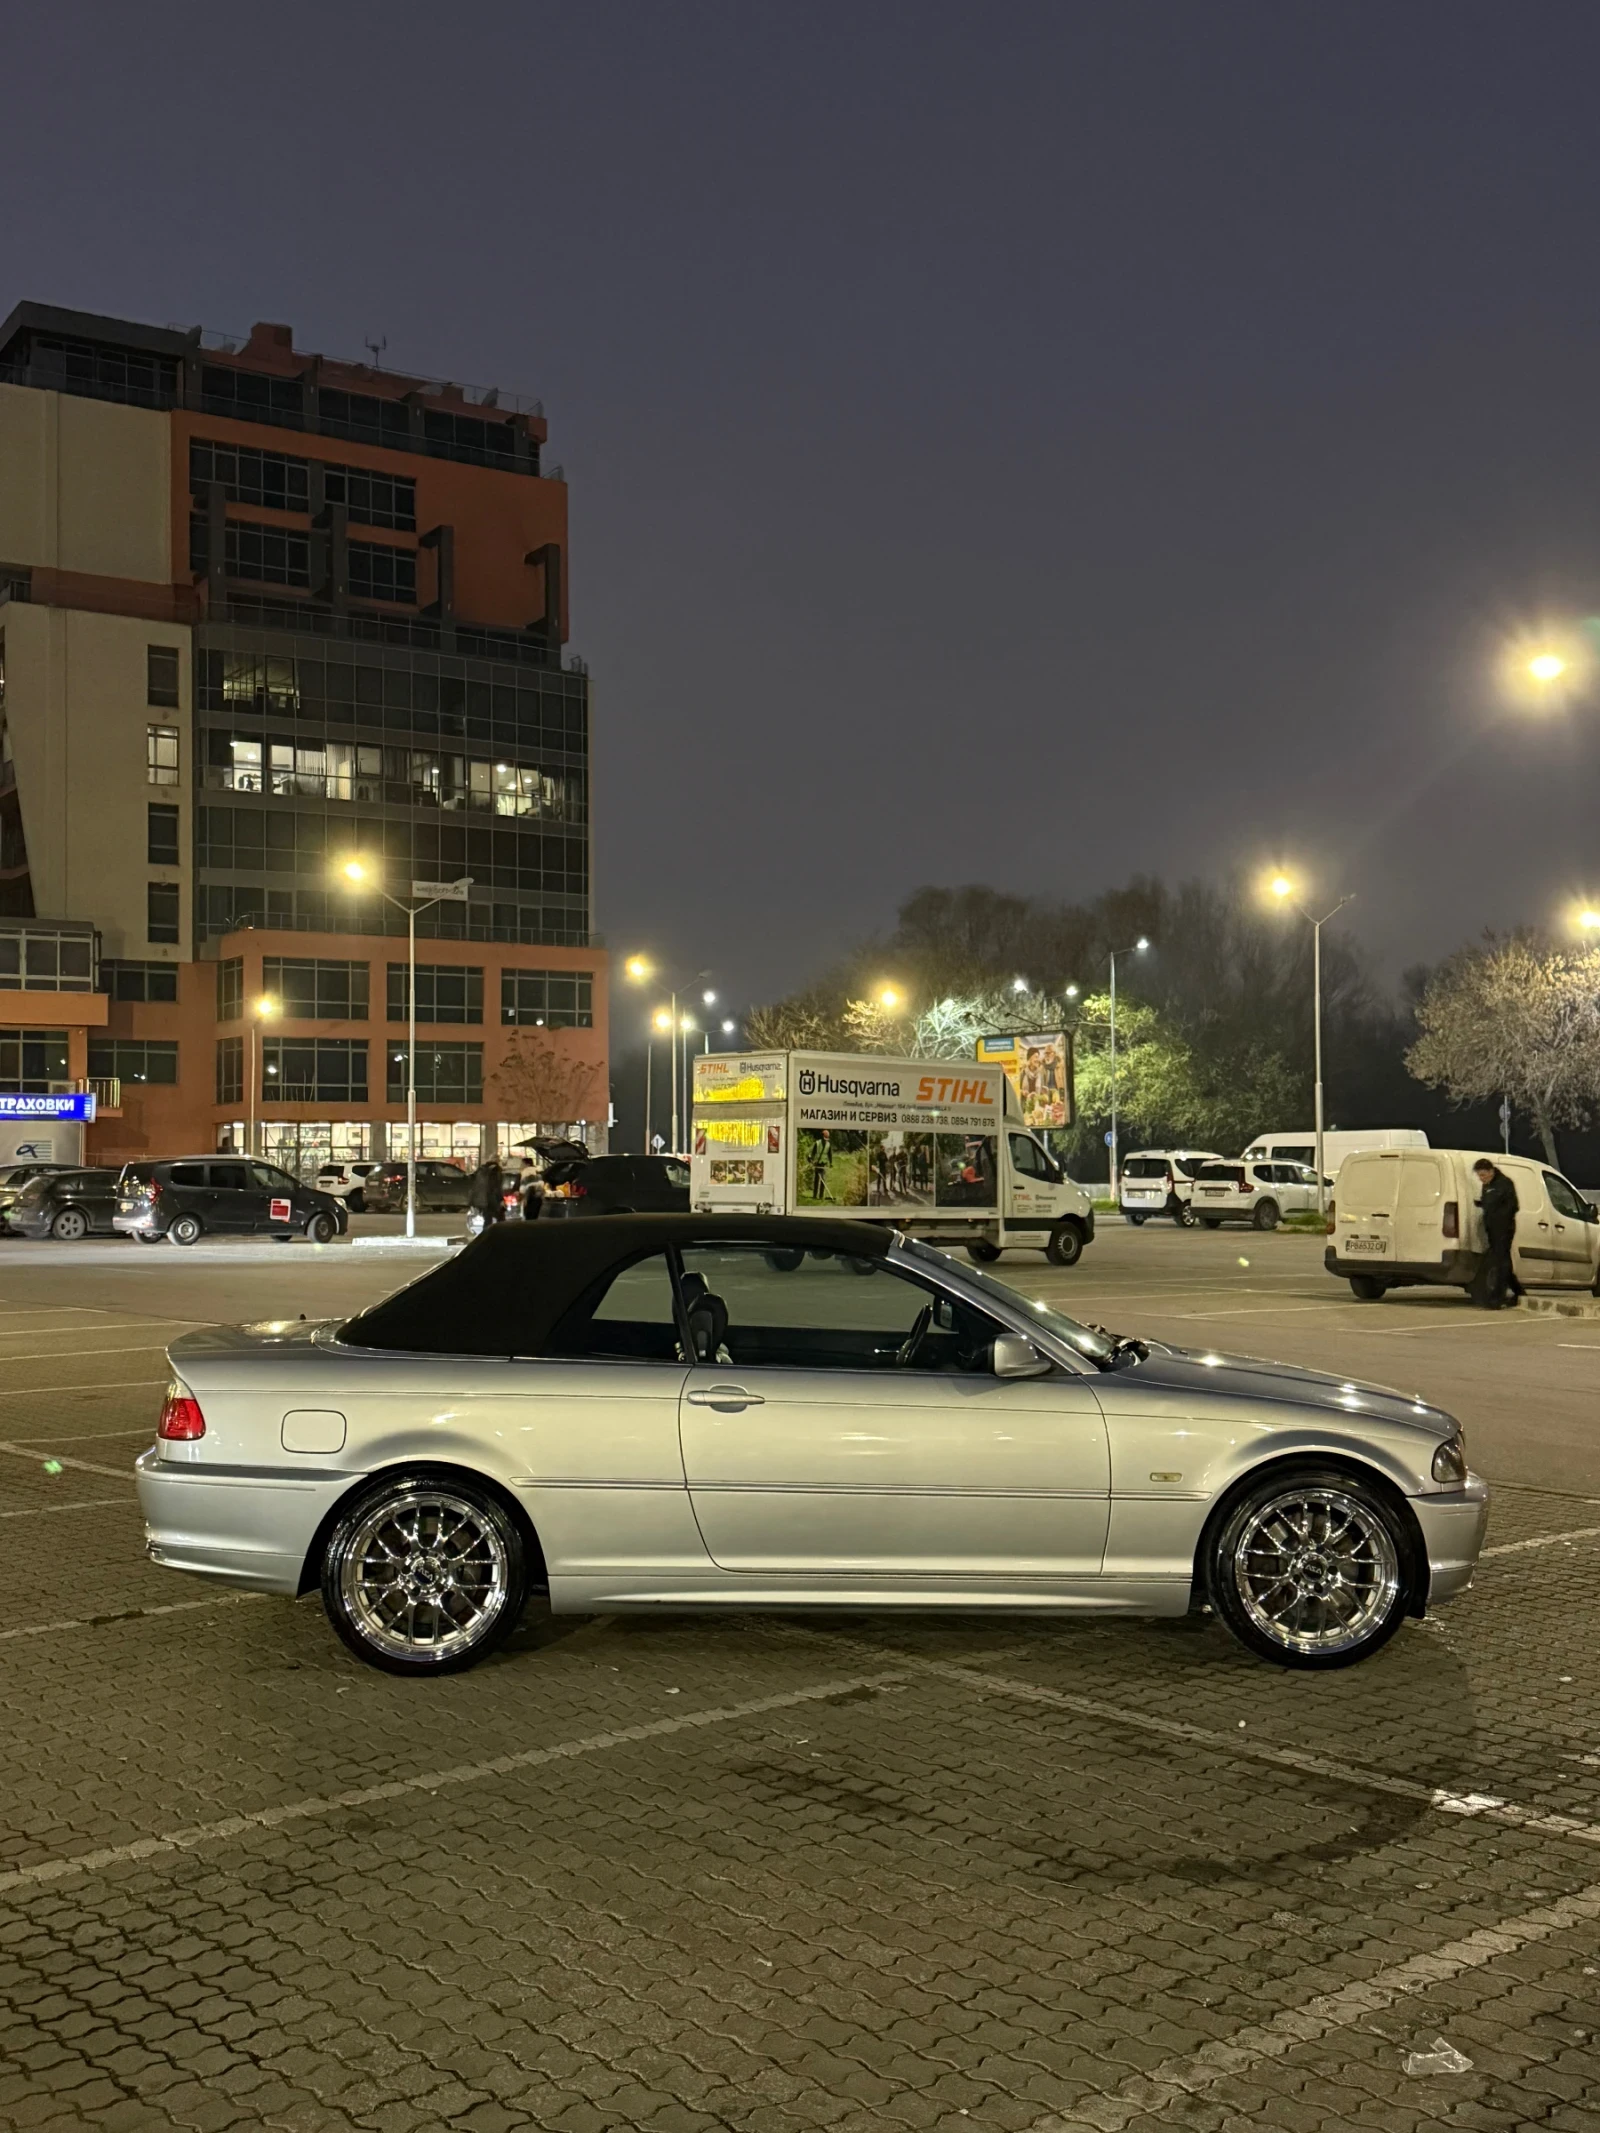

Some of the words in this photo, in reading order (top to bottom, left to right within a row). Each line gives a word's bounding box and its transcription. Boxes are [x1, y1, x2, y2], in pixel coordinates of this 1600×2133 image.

[699, 1063, 729, 1074] STIHL
[817, 1074, 900, 1098] Husqvarna
[916, 1077, 994, 1104] STIHL
[800, 1108, 847, 1121] МАГАЗИН
[849, 1111, 857, 1121] И
[858, 1111, 898, 1123] СЕРВИЗ
